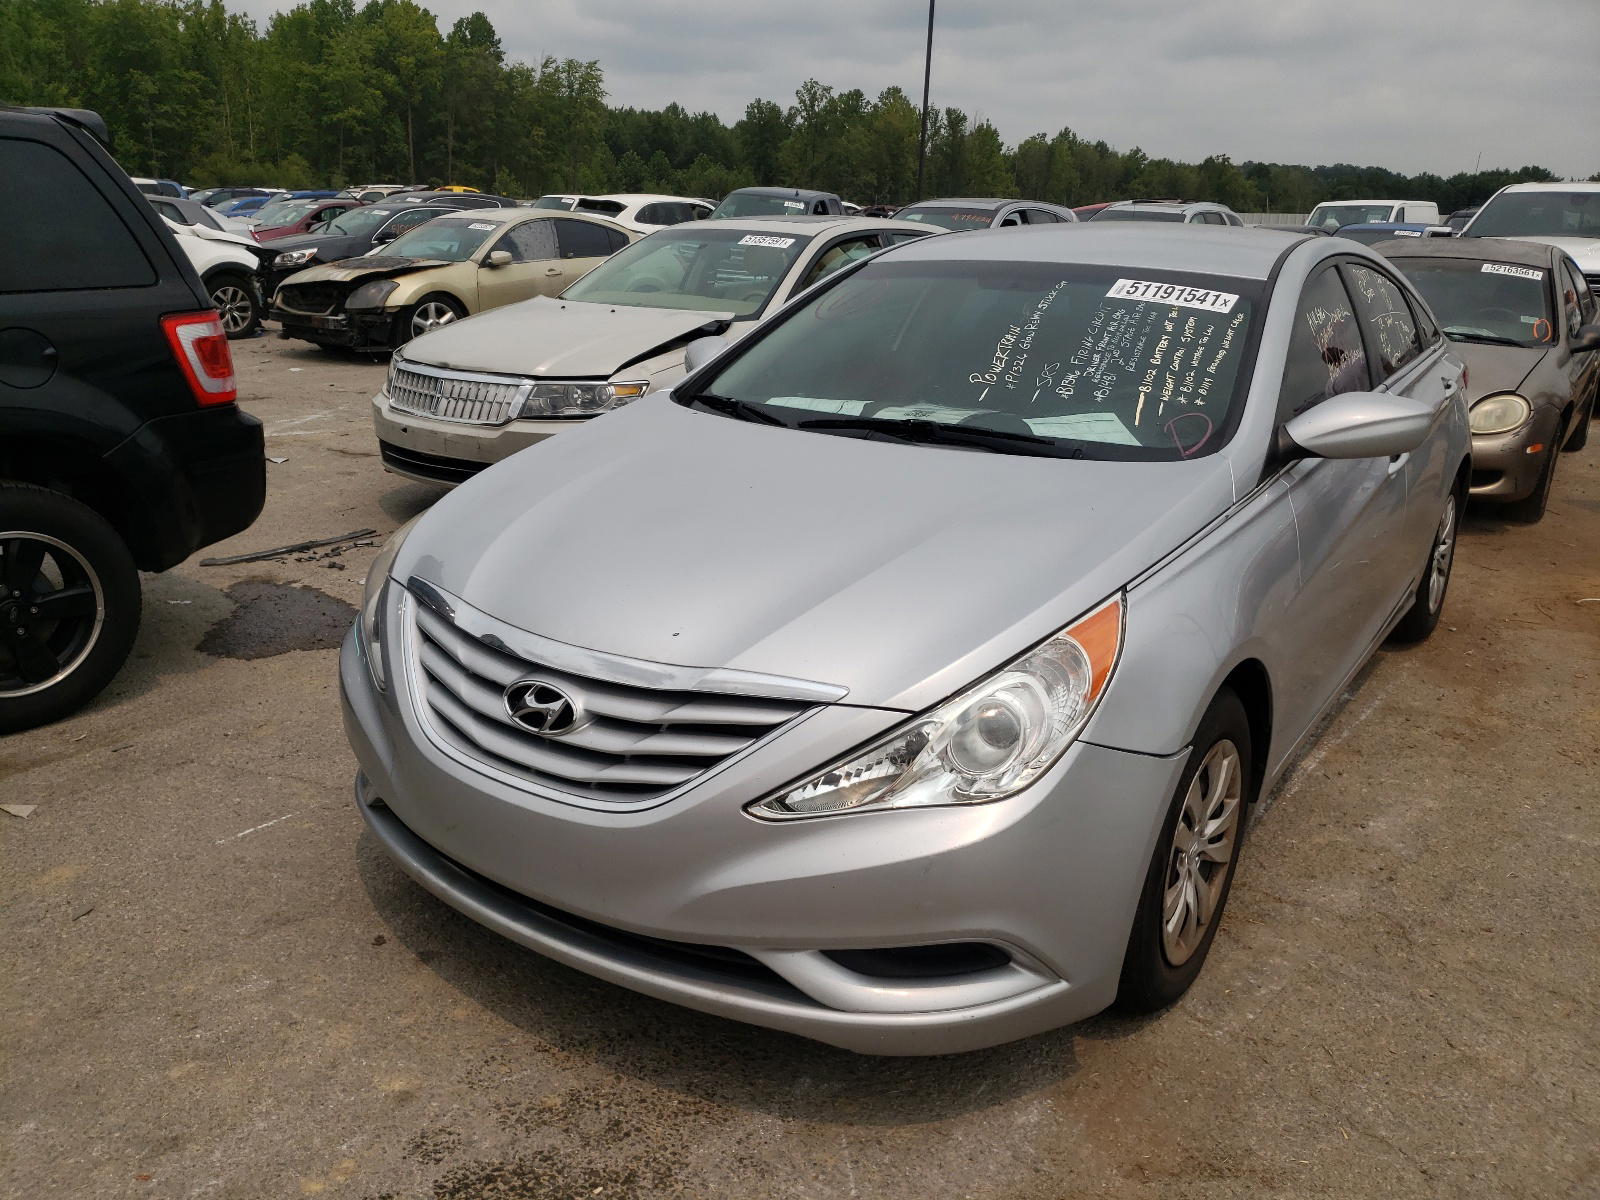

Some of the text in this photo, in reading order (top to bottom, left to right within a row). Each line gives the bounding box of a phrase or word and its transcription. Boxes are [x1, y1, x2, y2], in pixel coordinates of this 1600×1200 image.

[969, 325, 1021, 385] POWERTRAIN
[1070, 336, 1094, 365] FIRING
[1083, 353, 1101, 377] DRIVER
[1096, 331, 1111, 351] FRONT
[1139, 369, 1158, 393] B1102
[1150, 334, 1171, 365] BATTERY
[1160, 371, 1176, 402] WEIGHT
[1179, 369, 1195, 393] B1102
